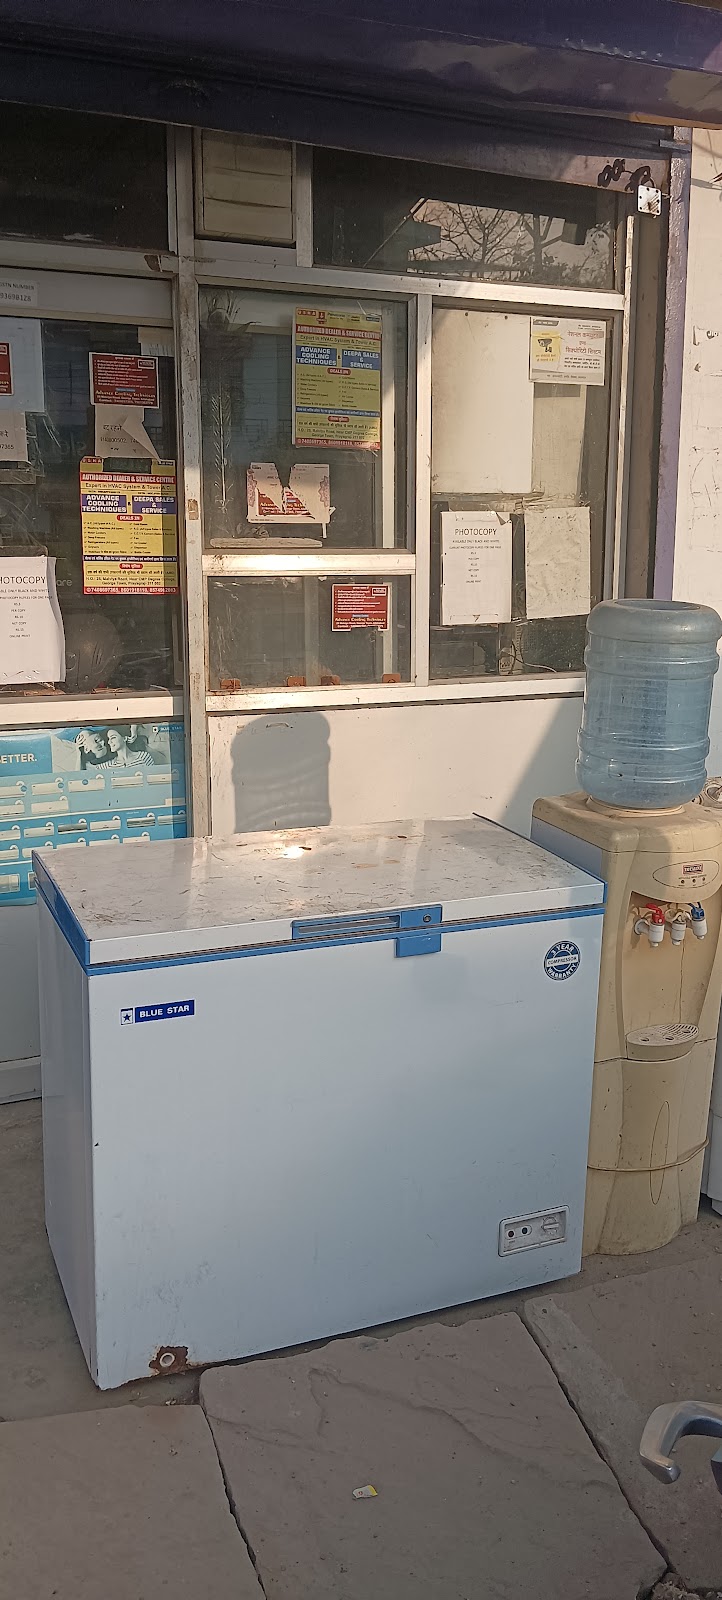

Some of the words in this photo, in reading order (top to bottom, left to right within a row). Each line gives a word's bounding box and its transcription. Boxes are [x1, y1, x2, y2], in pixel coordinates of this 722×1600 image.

[296, 358, 336, 366] TECHNIQUES
[0, 754, 37, 764] ETTER.
[556, 943, 574, 952] YEAR
[548, 956, 578, 965] COMPRESSOR
[548, 964, 576, 978] WARRANTY
[140, 1008, 163, 1018] BLUE
[166, 1005, 190, 1014] STAR
